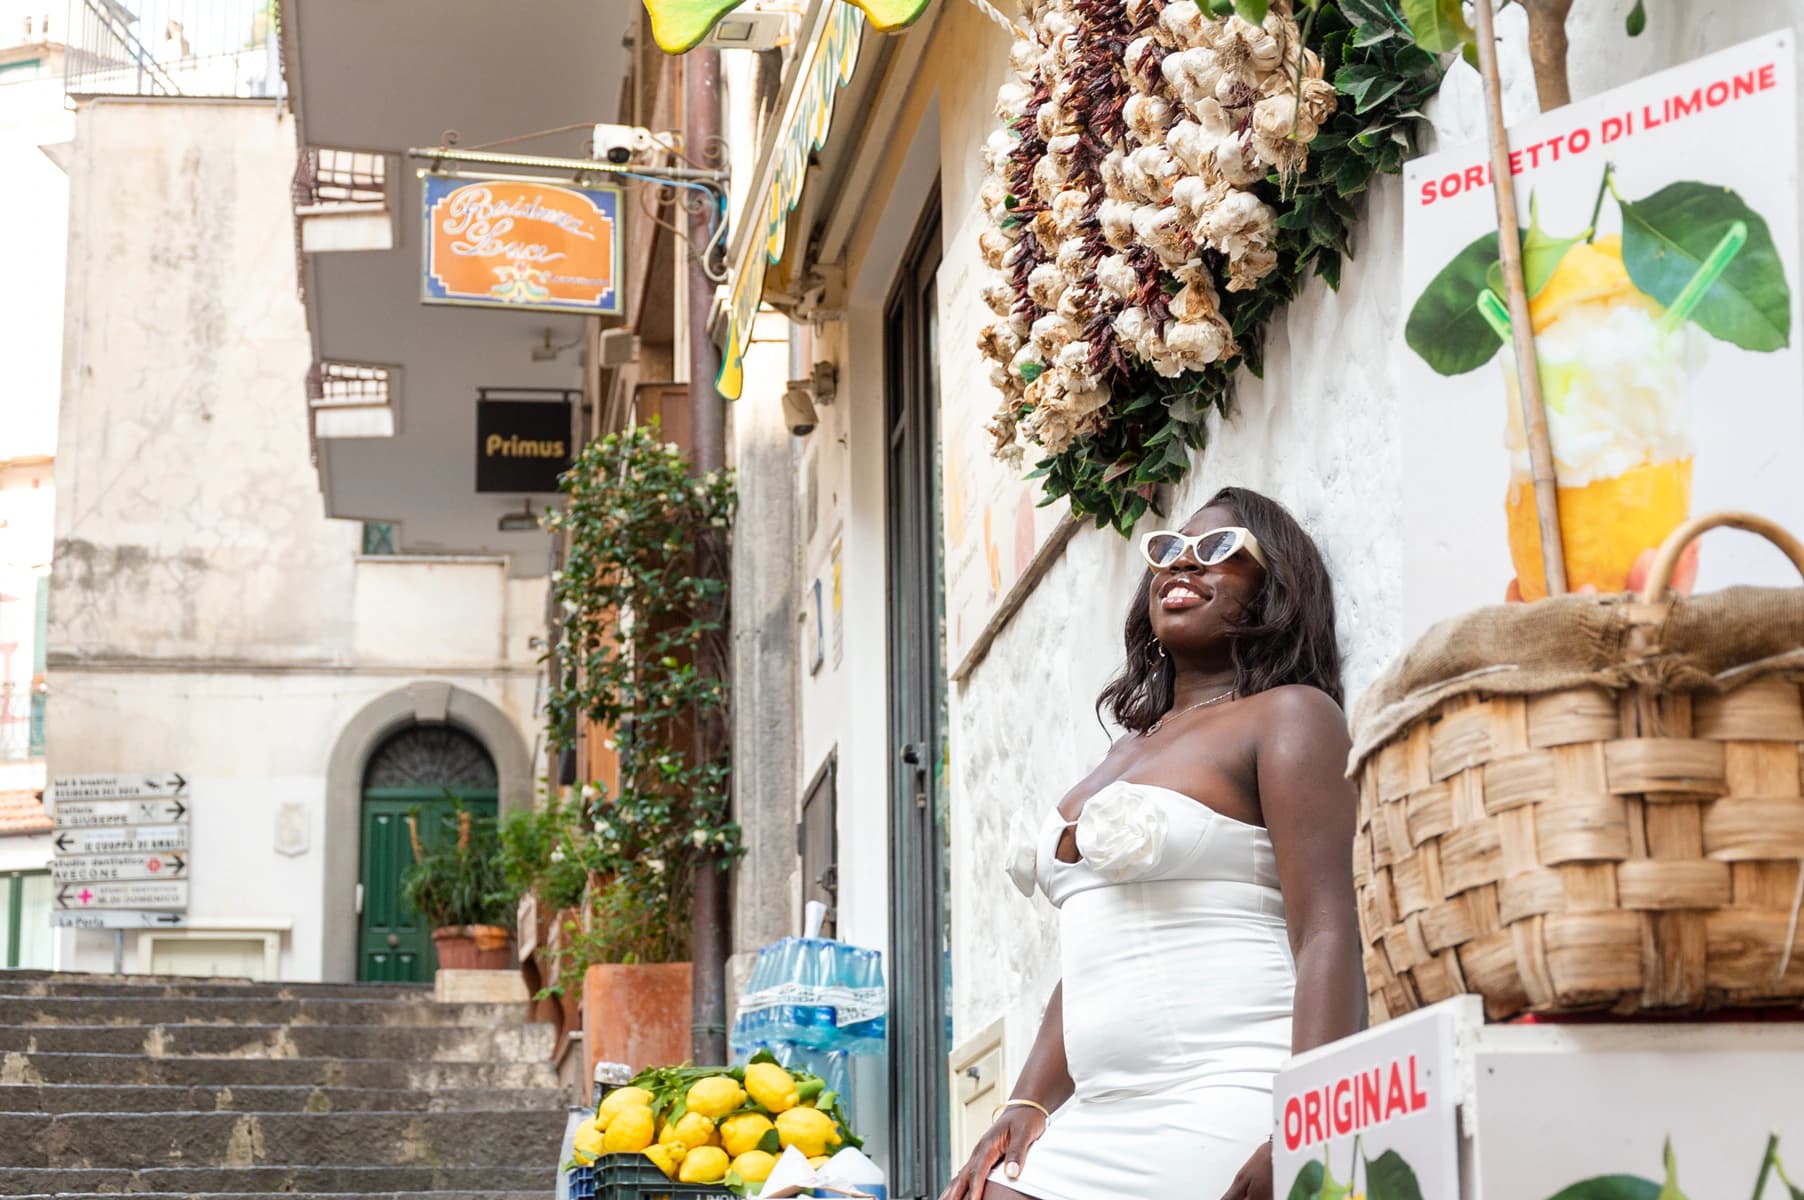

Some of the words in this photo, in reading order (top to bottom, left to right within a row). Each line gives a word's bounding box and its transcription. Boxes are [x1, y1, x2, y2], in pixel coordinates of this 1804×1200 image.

[1421, 128, 1591, 206] SORETTO
[1602, 112, 1633, 145] DI
[1642, 63, 1777, 130] LIMONE
[485, 433, 565, 457] Primus
[1284, 1054, 1427, 1151] ORIGINAL
